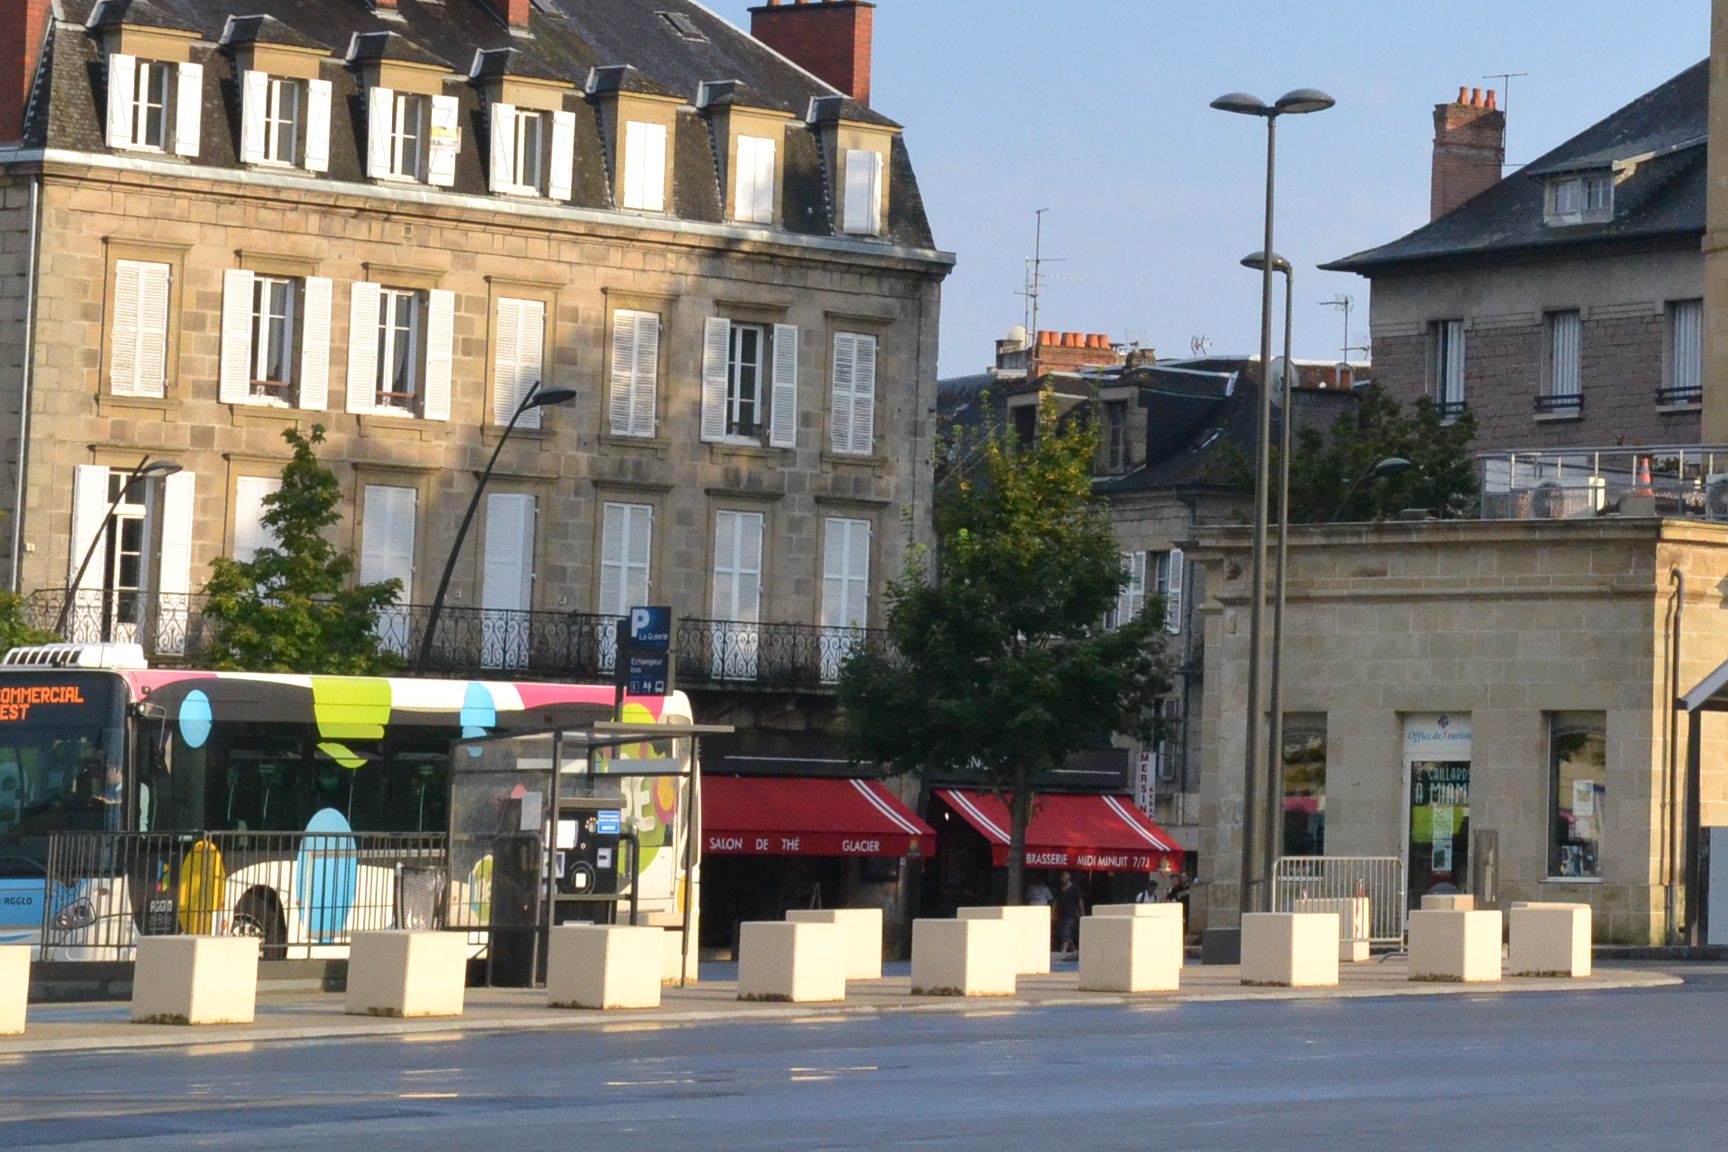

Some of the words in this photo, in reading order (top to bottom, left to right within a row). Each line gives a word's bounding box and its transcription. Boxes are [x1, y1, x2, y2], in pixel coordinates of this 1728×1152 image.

[631, 608, 650, 638] P
[0, 686, 84, 704] OMMERCIAL
[1408, 731, 1431, 743] Office
[1432, 731, 1441, 740] de
[1443, 730, 1472, 740] Tourism
[1140, 753, 1149, 813] MERSIN
[1430, 782, 1469, 804] MIAM
[709, 838, 743, 850] SALON
[756, 838, 769, 850] DE
[782, 836, 800, 850] THÉ
[842, 839, 880, 852] GLACIER
[1026, 853, 1068, 865] BRASSERIE
[1077, 855, 1097, 866] MIDI
[1097, 855, 1128, 867] MINUIT
[1132, 857, 1150, 868] 7/7J
[3, 896, 33, 906] AGGLO
